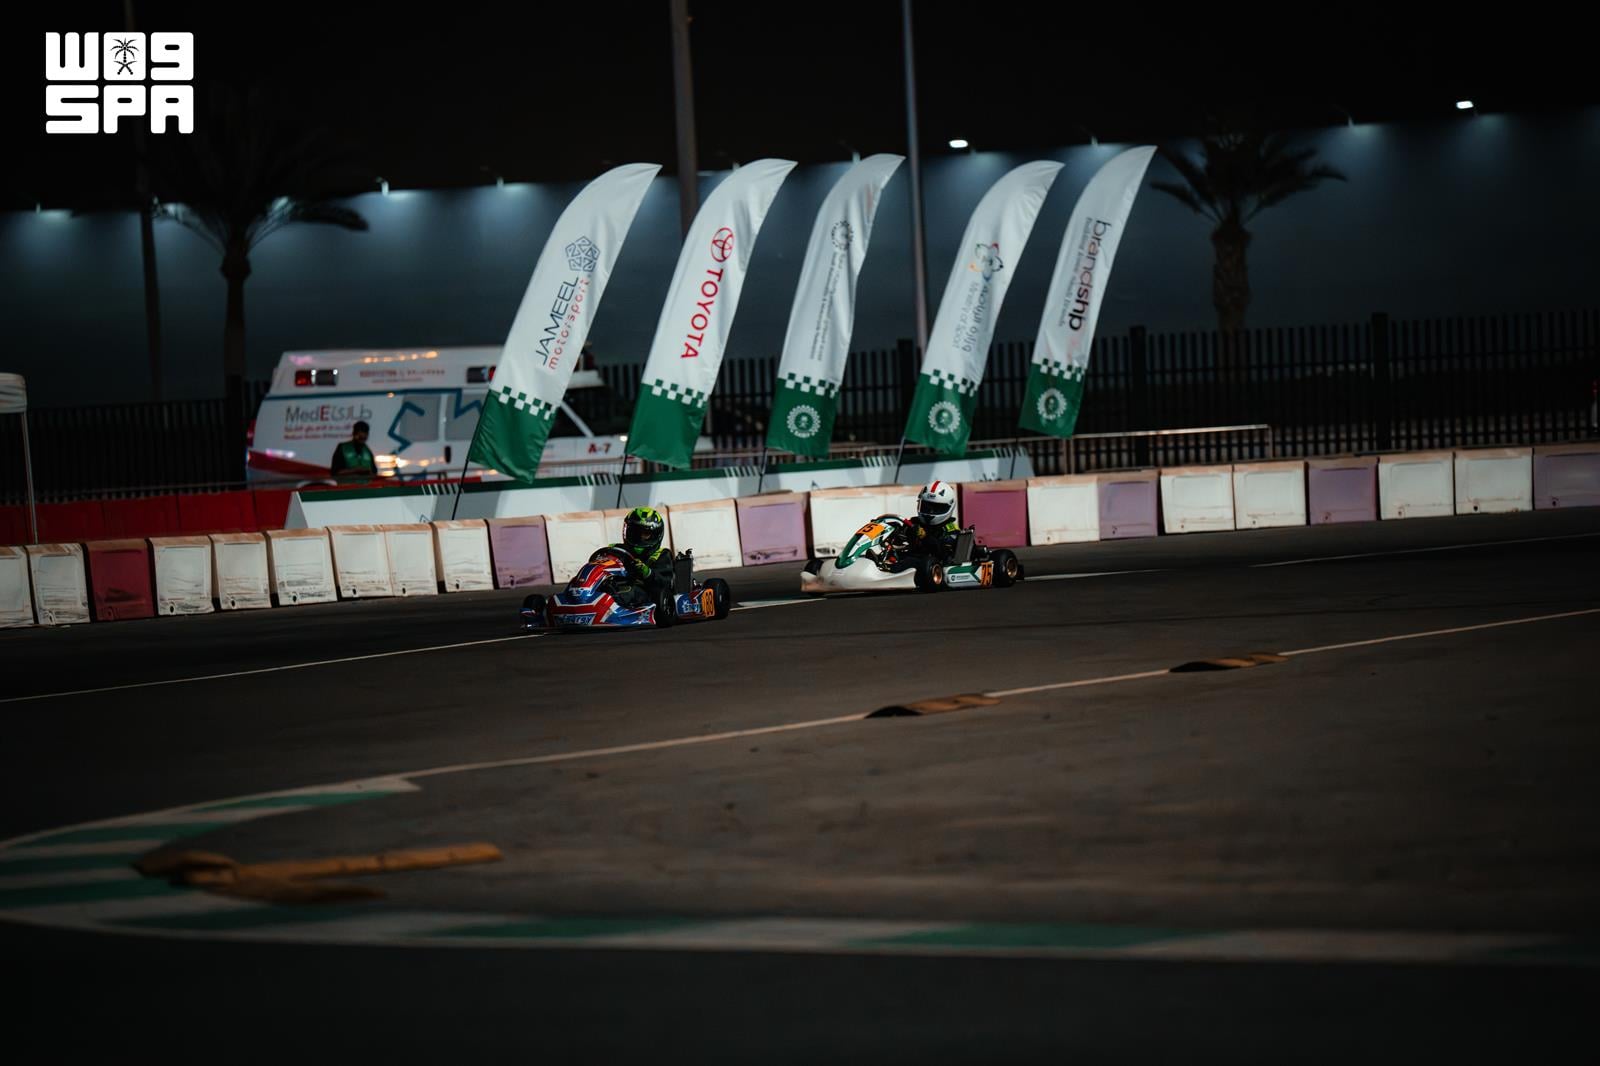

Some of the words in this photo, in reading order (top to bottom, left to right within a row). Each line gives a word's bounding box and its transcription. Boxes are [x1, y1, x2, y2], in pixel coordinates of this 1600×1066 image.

[535, 278, 578, 365] JAMEEL
[547, 278, 590, 372] motorsport
[681, 268, 724, 360] TOYOTA
